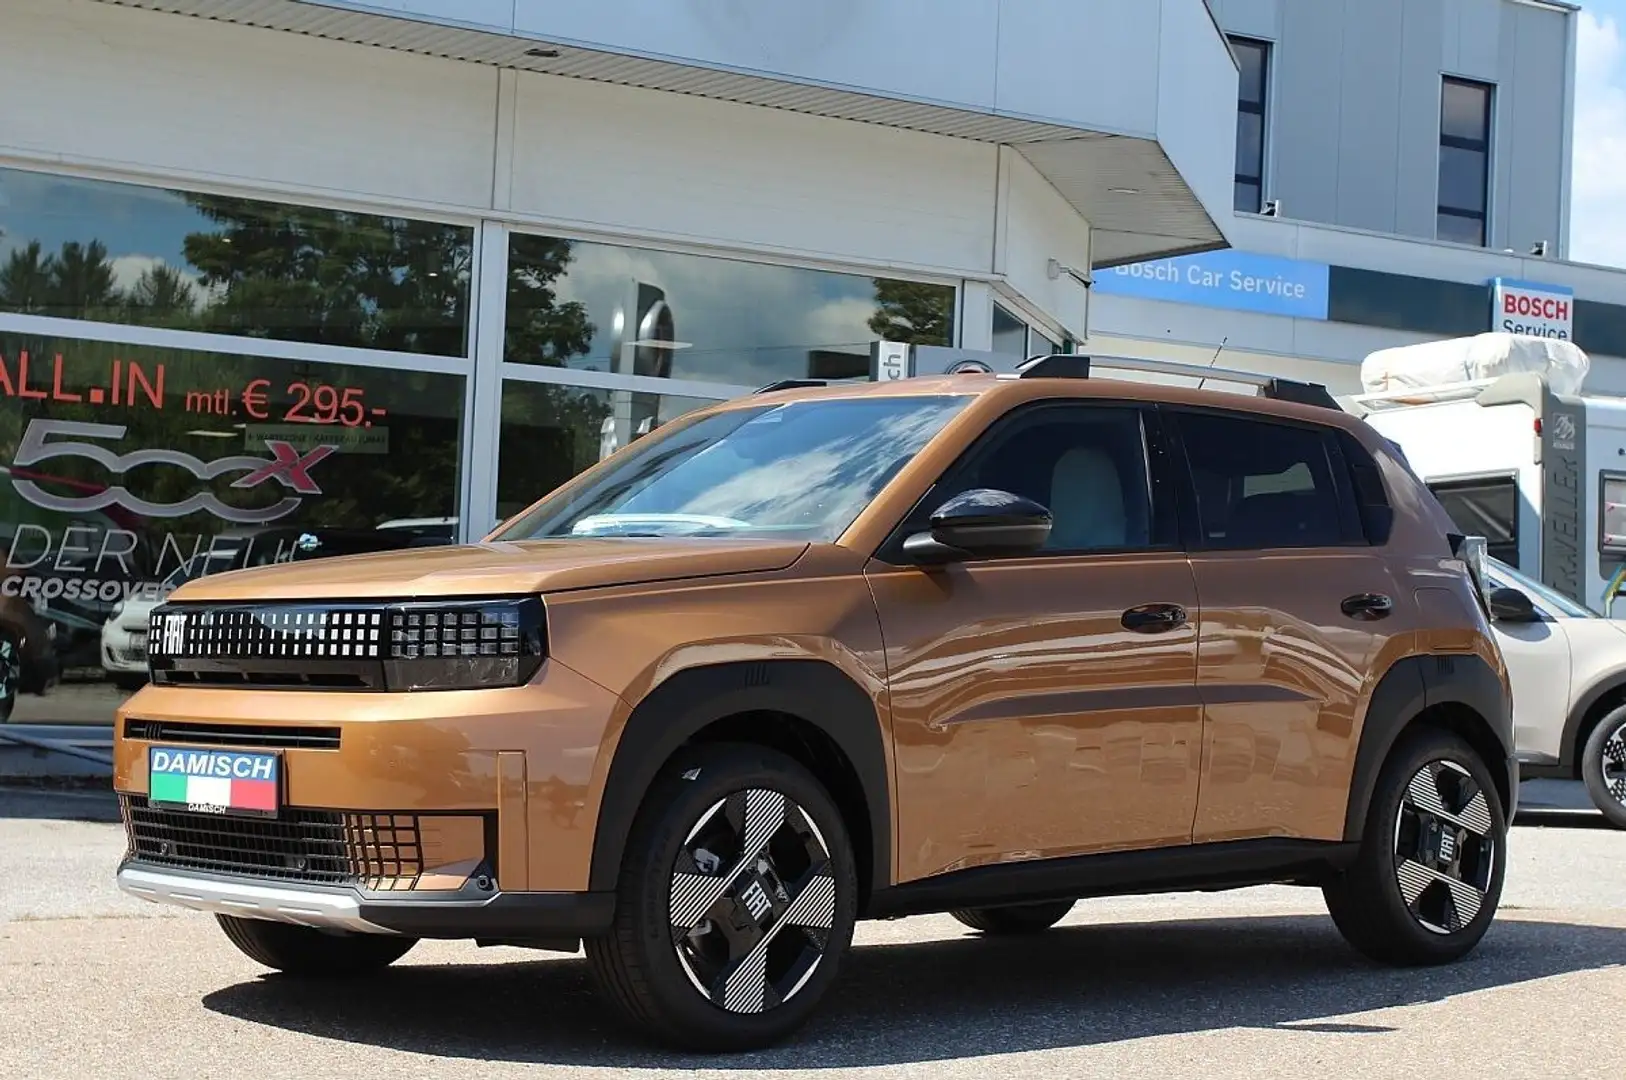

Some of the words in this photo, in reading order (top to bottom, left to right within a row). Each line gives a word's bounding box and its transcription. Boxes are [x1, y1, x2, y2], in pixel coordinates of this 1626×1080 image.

[1187, 264, 1223, 288] Car
[1230, 270, 1305, 298] Service
[1504, 293, 1568, 321] BOSCH
[1503, 319, 1568, 340] Service
[186, 387, 237, 416] mtl.
[241, 379, 270, 419] €
[283, 382, 387, 428] 295.-
[5, 523, 138, 573] DER
[162, 615, 187, 655] FIAT
[153, 751, 273, 779] DAMISCH
[741, 880, 772, 922] FIAT
